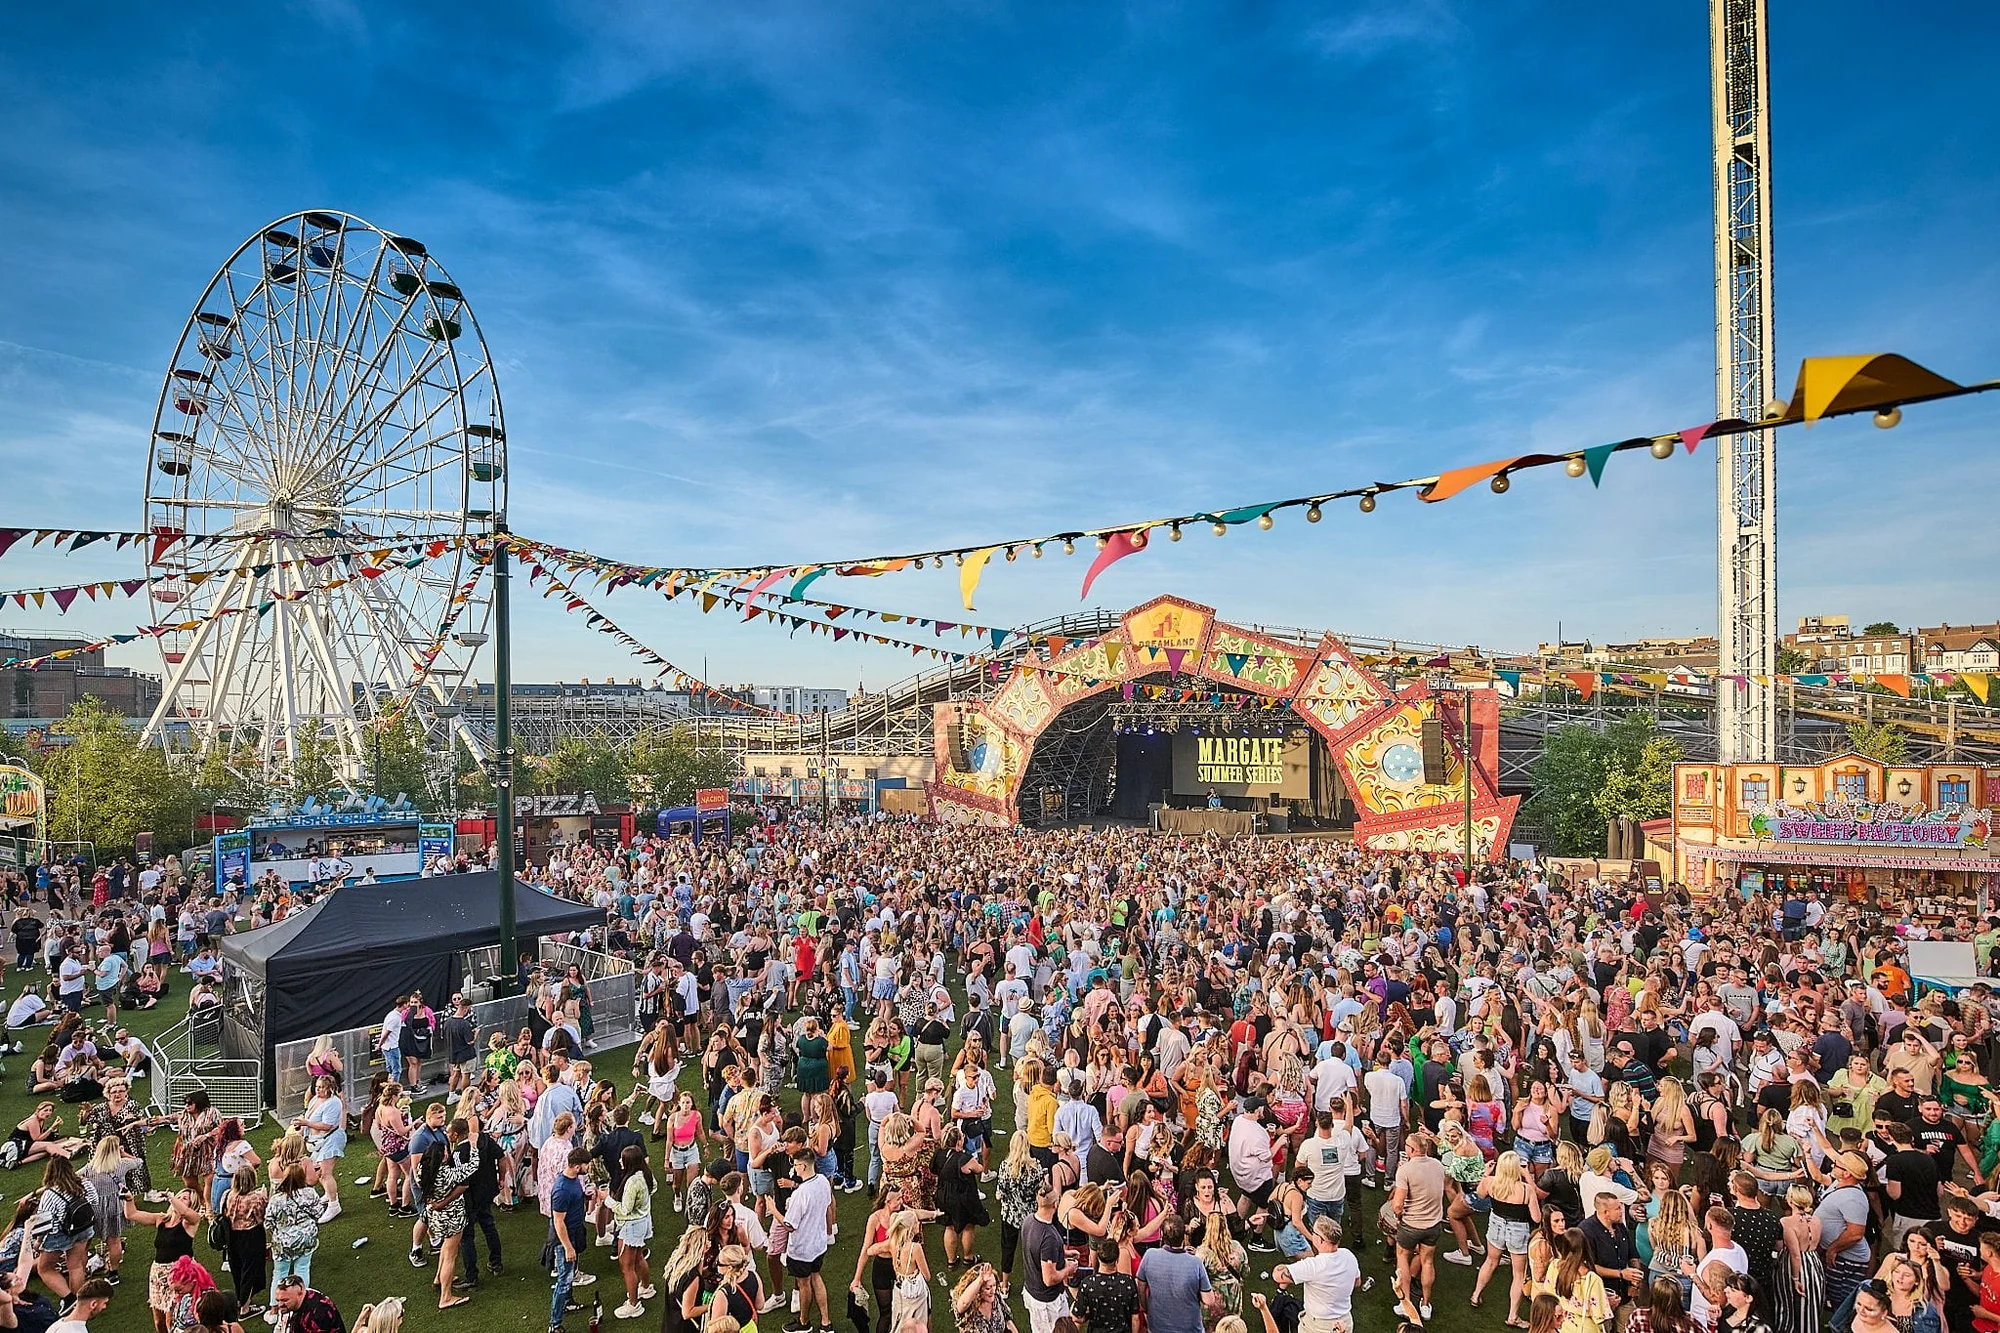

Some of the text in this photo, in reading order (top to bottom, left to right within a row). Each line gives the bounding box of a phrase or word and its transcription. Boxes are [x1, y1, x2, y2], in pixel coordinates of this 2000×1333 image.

[1139, 638, 1195, 648] DREAMLAND
[1197, 737, 1283, 765] MARGATE
[805, 757, 839, 767] MAIN
[811, 767, 835, 778] BAR
[1197, 765, 1283, 784] SUMMER SERIES
[5, 788, 37, 816] TRAIN
[513, 794, 602, 817] PIZZA
[701, 795, 725, 804] NACHOS
[342, 812, 383, 824] CHIPS
[1779, 821, 1961, 843] SWEET FACTORY
